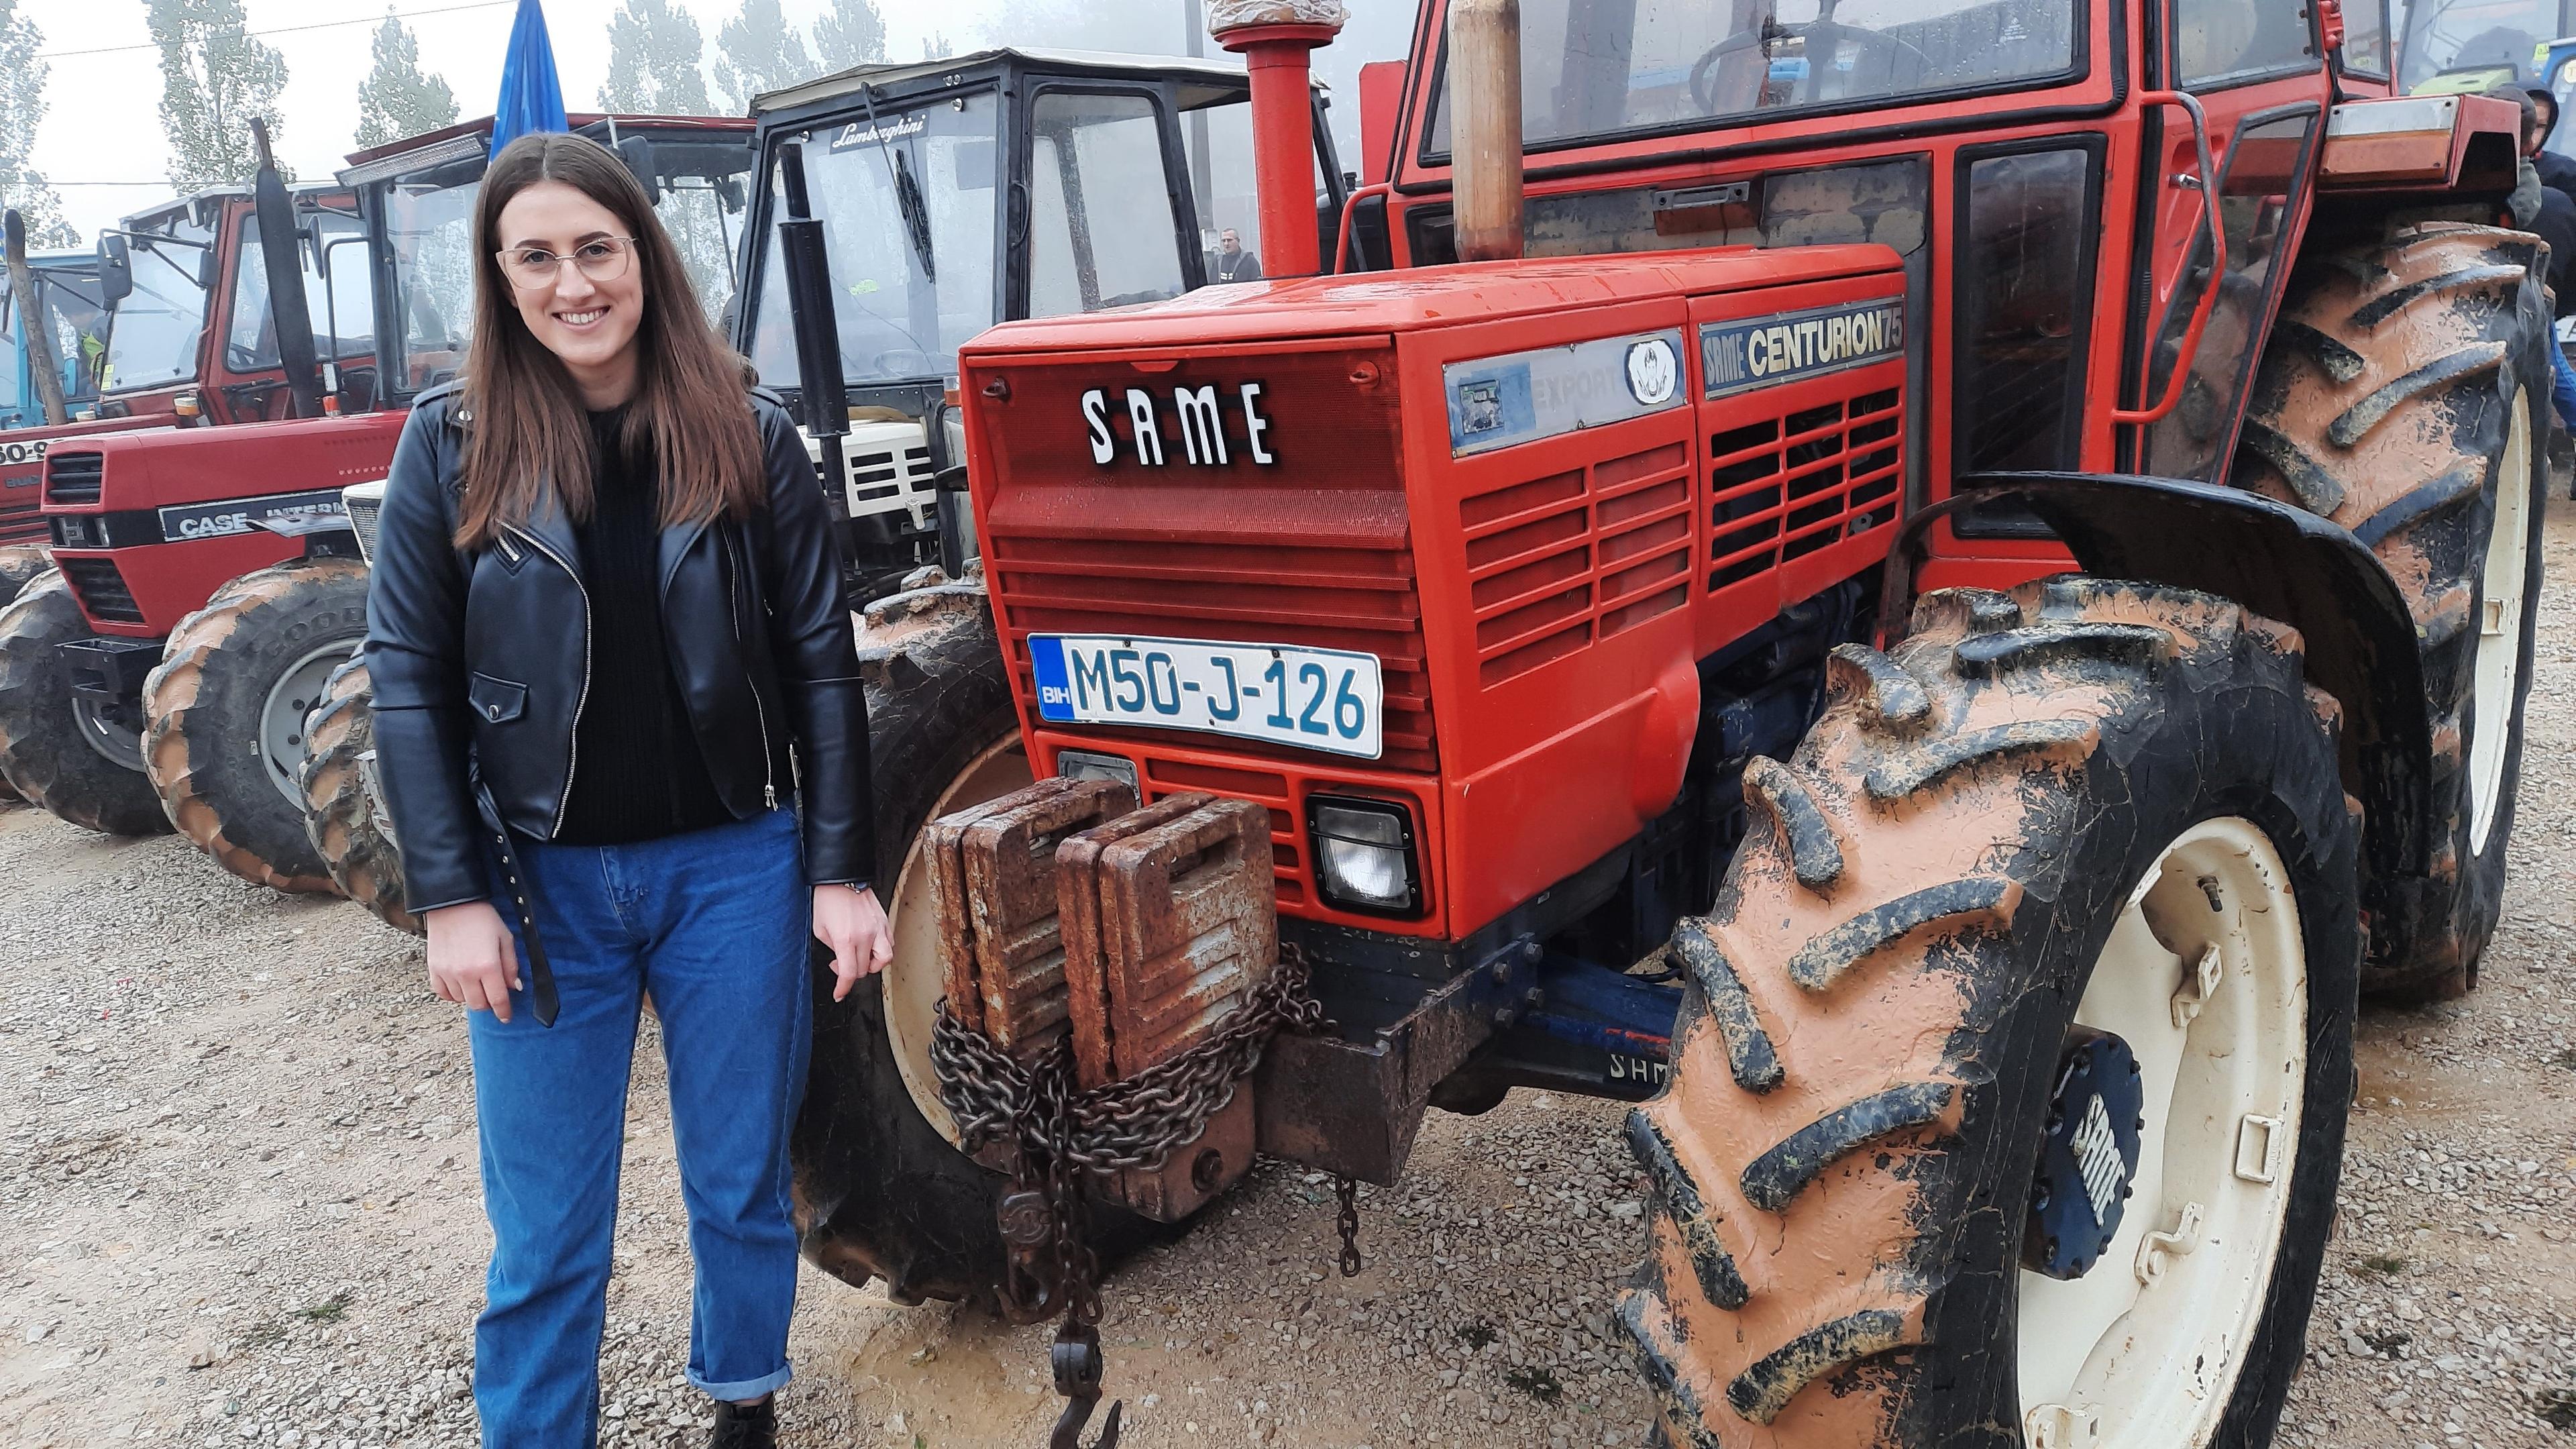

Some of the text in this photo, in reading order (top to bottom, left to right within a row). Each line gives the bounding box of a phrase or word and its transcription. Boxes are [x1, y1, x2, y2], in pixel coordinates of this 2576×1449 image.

[833, 115, 926, 148] Lamborghini
[1703, 307, 1903, 385] SAME CENTURION 75
[1081, 383, 1273, 466] SAME
[179, 512, 248, 535] CASE
[1042, 686, 1072, 705] BIH
[1072, 647, 1366, 741] M50-J-126
